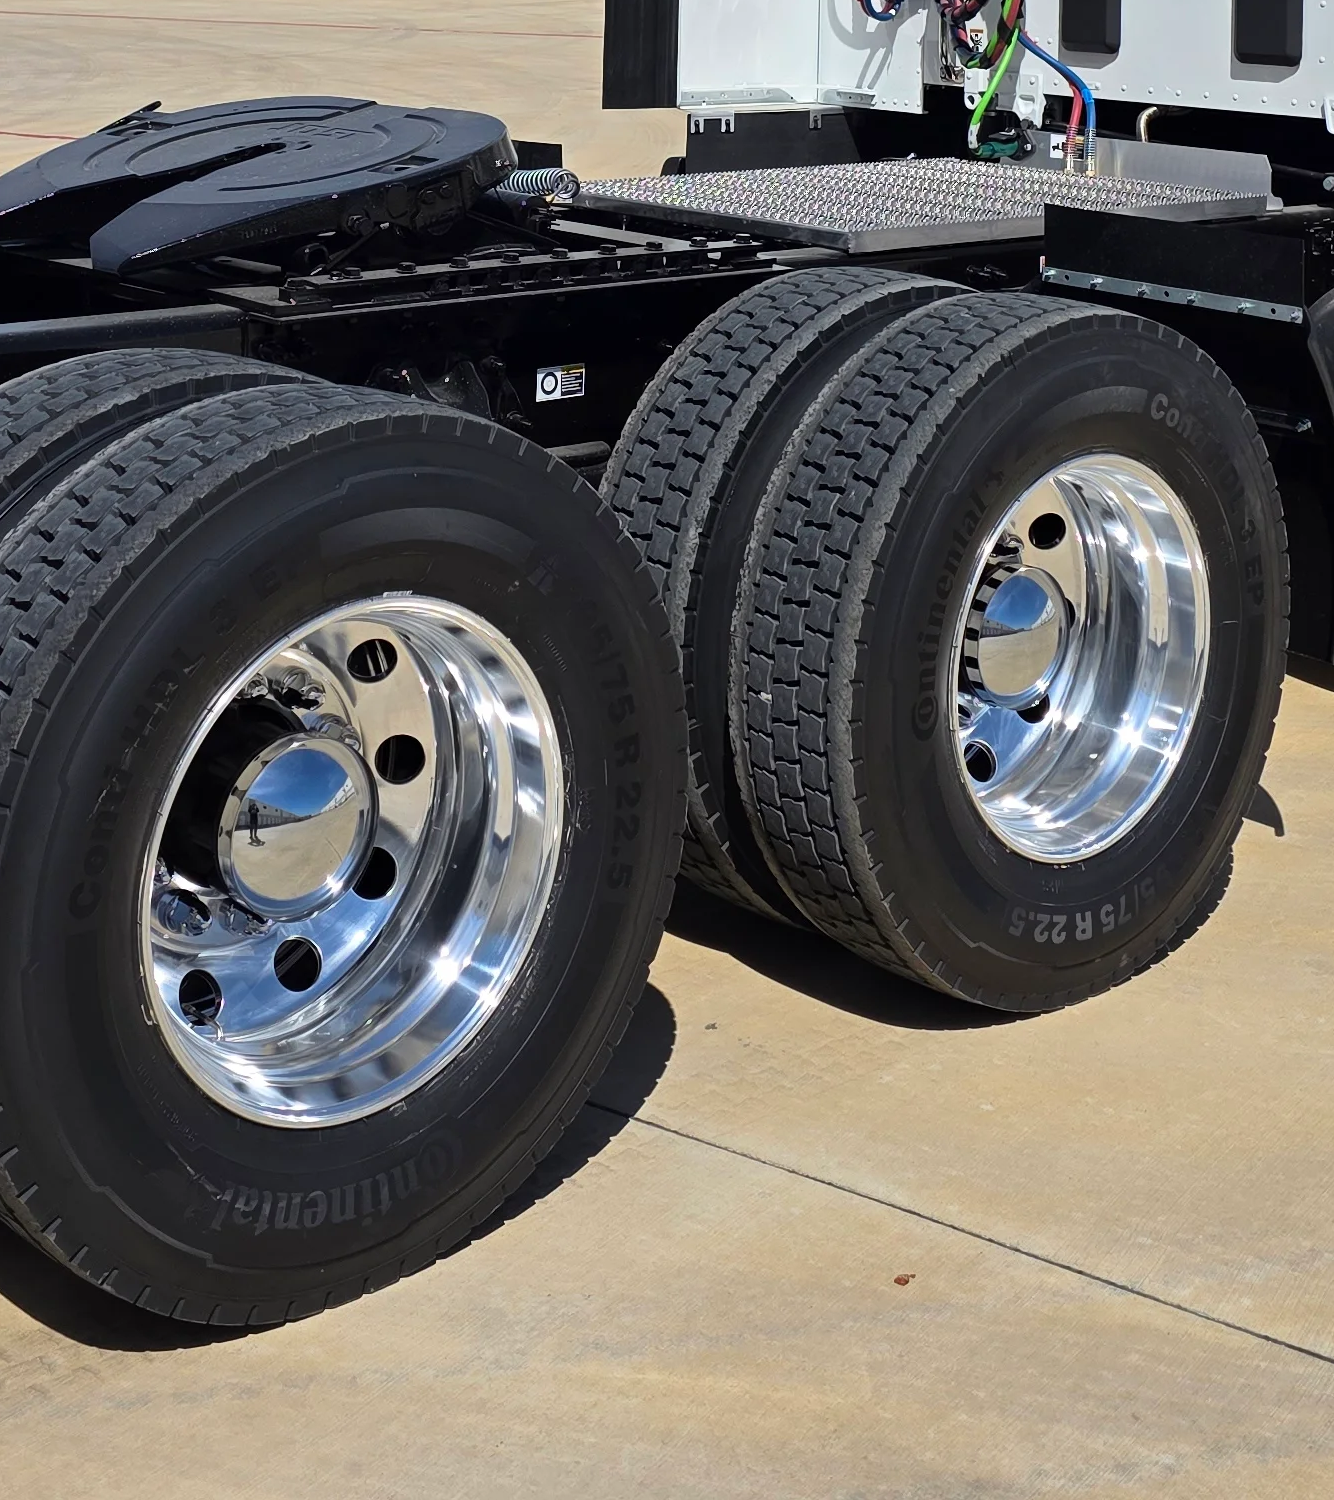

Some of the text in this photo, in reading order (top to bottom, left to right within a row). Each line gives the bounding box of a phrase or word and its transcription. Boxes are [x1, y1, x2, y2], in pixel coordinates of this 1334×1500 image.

[911, 487, 988, 742] Continental
[614, 732, 644, 769] R
[606, 780, 644, 891] 22.5
[1008, 906, 1068, 944] 22.5
[1075, 910, 1093, 942] R
[207, 1129, 464, 1237] Continental
